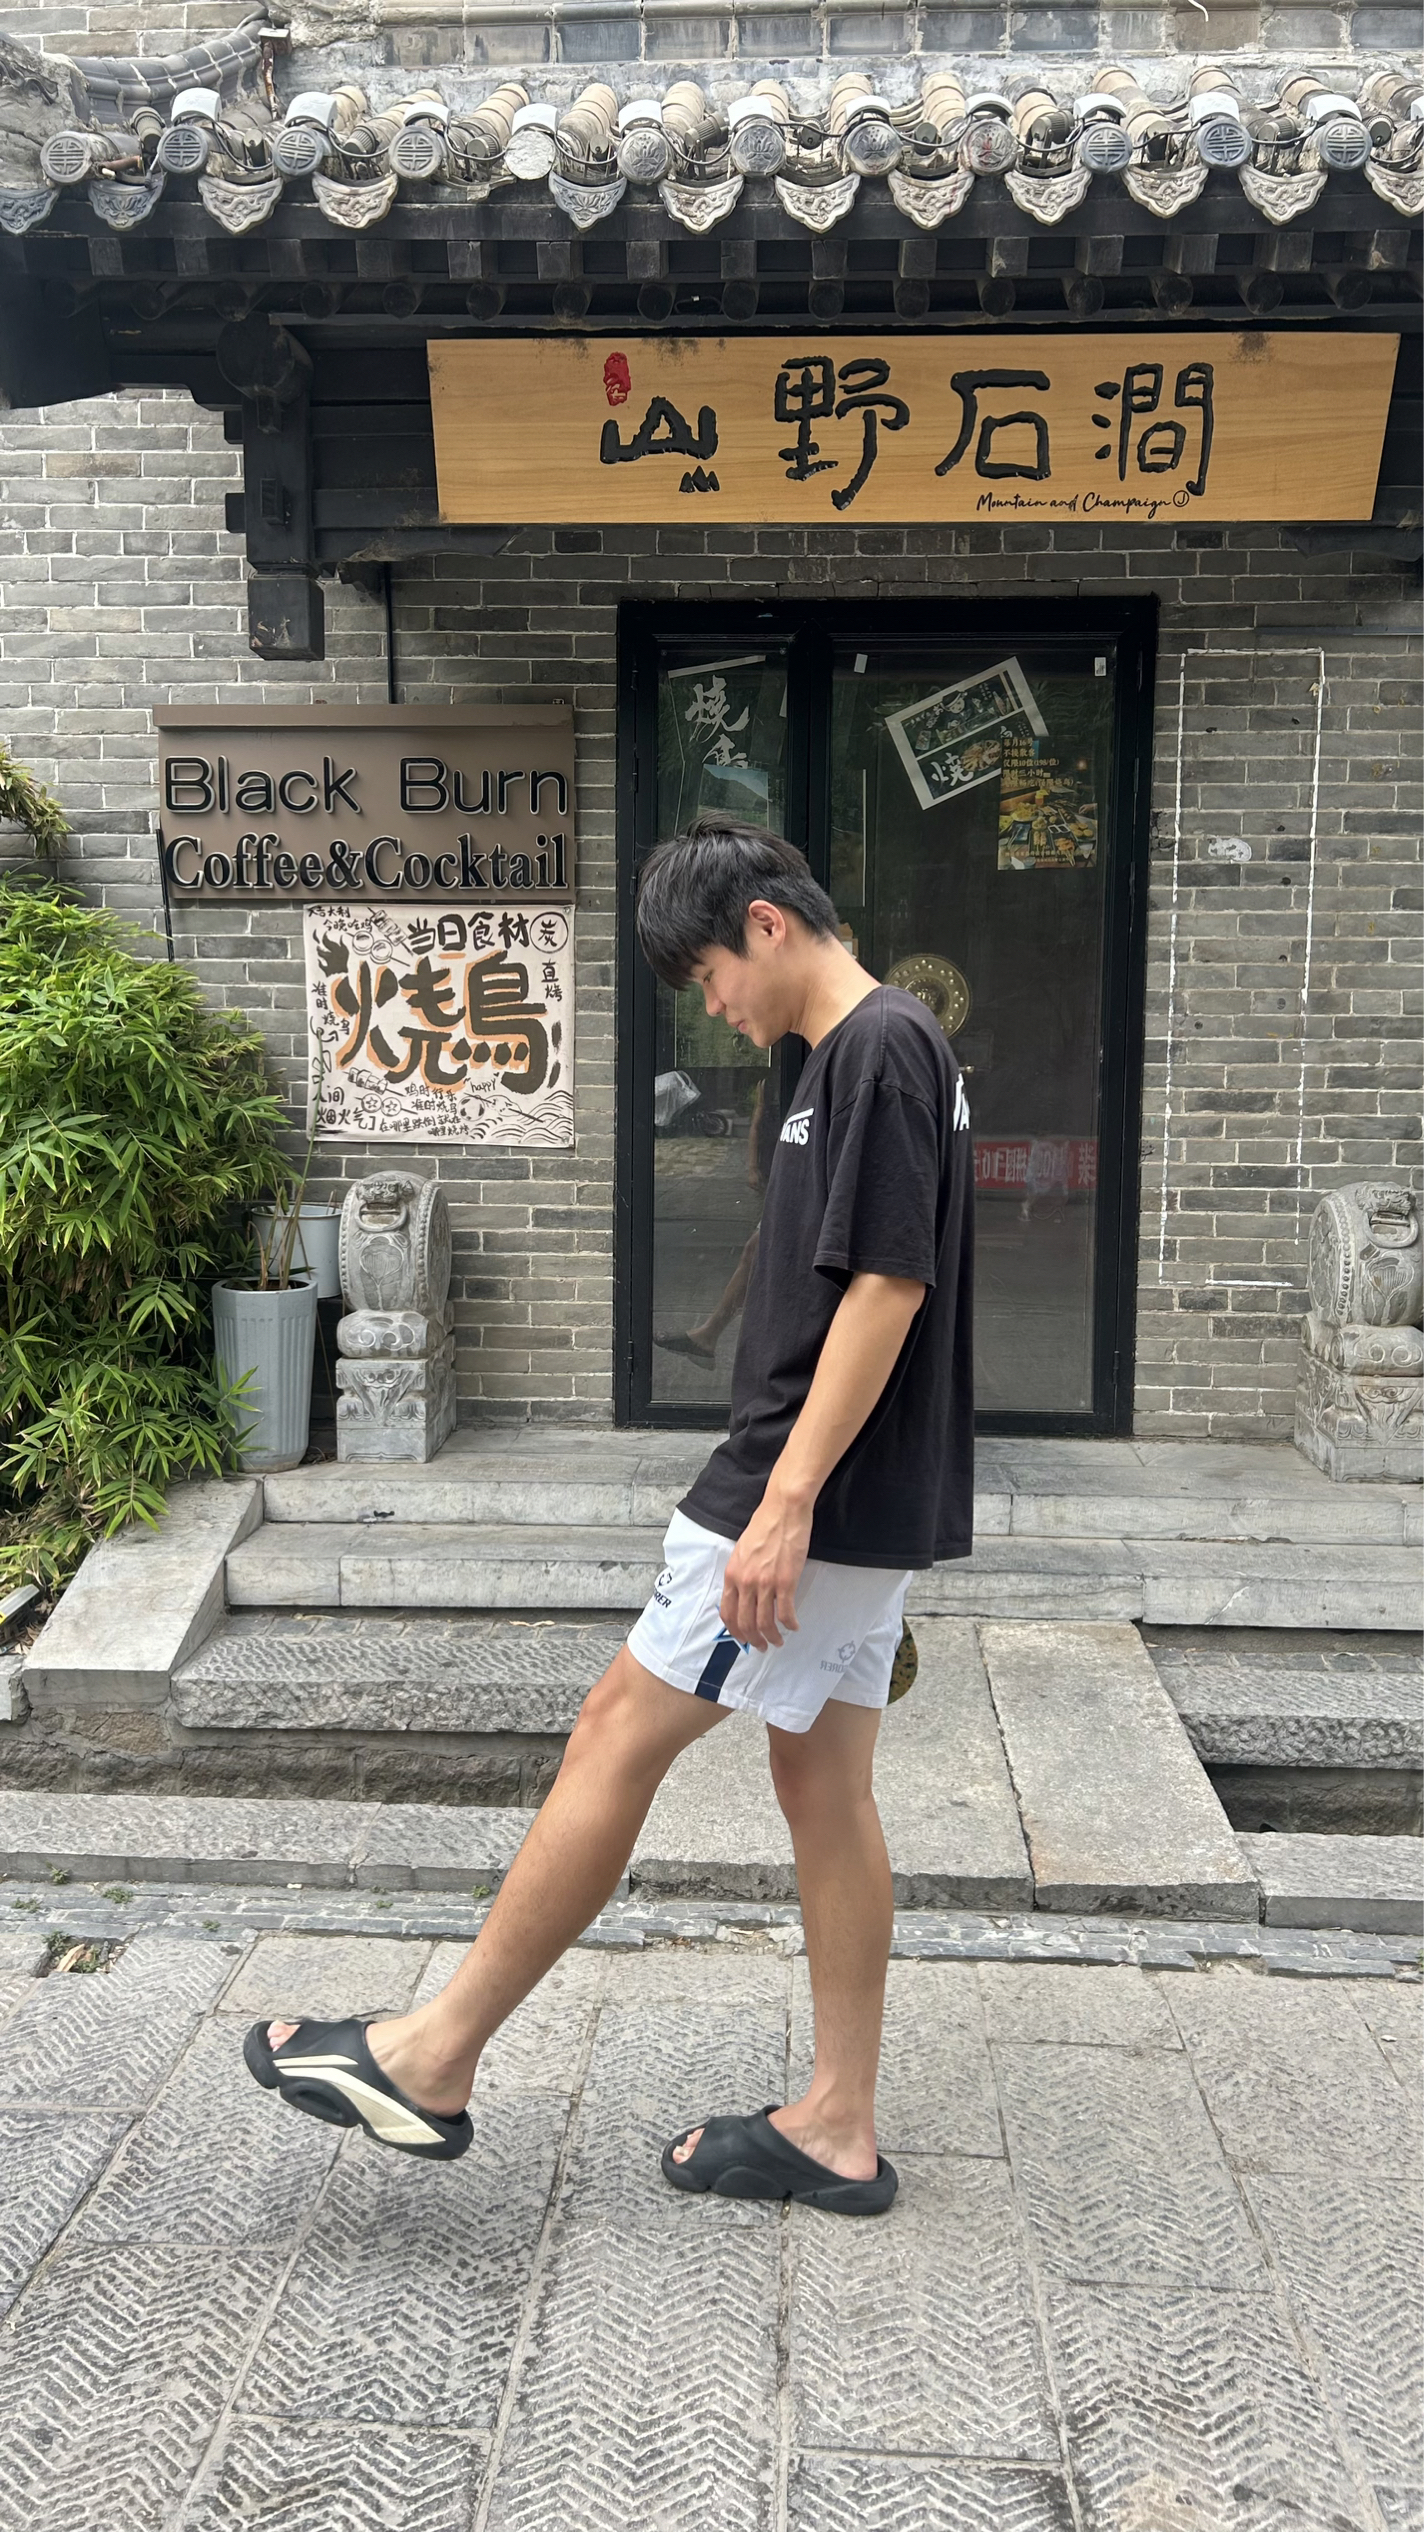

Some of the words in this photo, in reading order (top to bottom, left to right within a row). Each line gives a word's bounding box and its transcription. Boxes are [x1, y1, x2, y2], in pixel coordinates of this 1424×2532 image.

[977, 492, 1048, 511] Mountain
[1050, 493, 1079, 512] and
[1083, 491, 1171, 519] Champaign
[165, 755, 361, 814] Black
[400, 755, 568, 815] Burn
[166, 832, 569, 890] Coffee&Cocktail
[323, 918, 372, 932] 今晚吃鸡
[407, 912, 530, 955] 当日食材
[470, 1078, 497, 1093] happy
